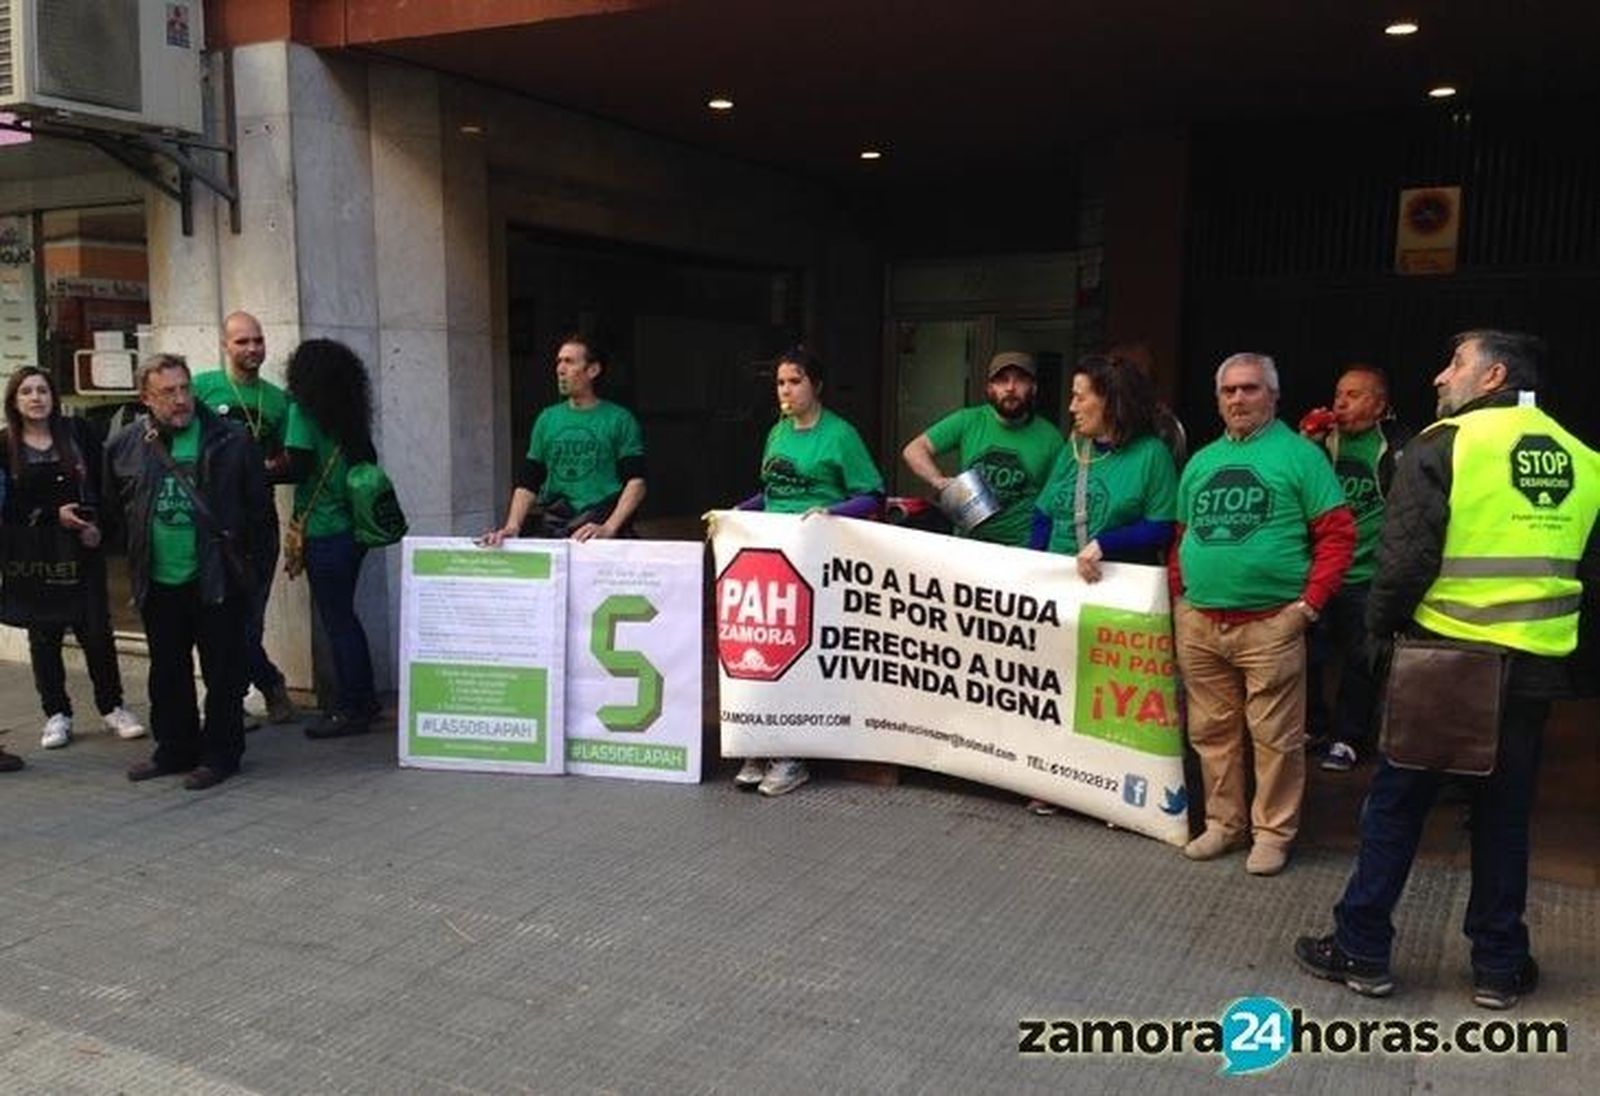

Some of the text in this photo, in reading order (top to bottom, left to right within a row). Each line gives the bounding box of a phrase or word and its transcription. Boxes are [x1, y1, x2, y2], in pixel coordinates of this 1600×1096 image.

[1517, 450, 1568, 475] STOP
[1196, 487, 1264, 514] STOP
[1341, 475, 1374, 498] OP
[720, 576, 797, 625] PAH
[822, 556, 1060, 627] ¡NO A LA DEUDA
[719, 623, 796, 645] ZAMORA
[844, 588, 1036, 651] DE POR VIDA!
[1097, 627, 1172, 651] DACIO
[590, 594, 664, 732] 5
[820, 626, 1062, 695] DERECHO A UNA
[1089, 648, 1174, 676] EN PAG
[817, 655, 1061, 725] VIVIENDA DIGNA
[1092, 680, 1177, 726] ¡YA
